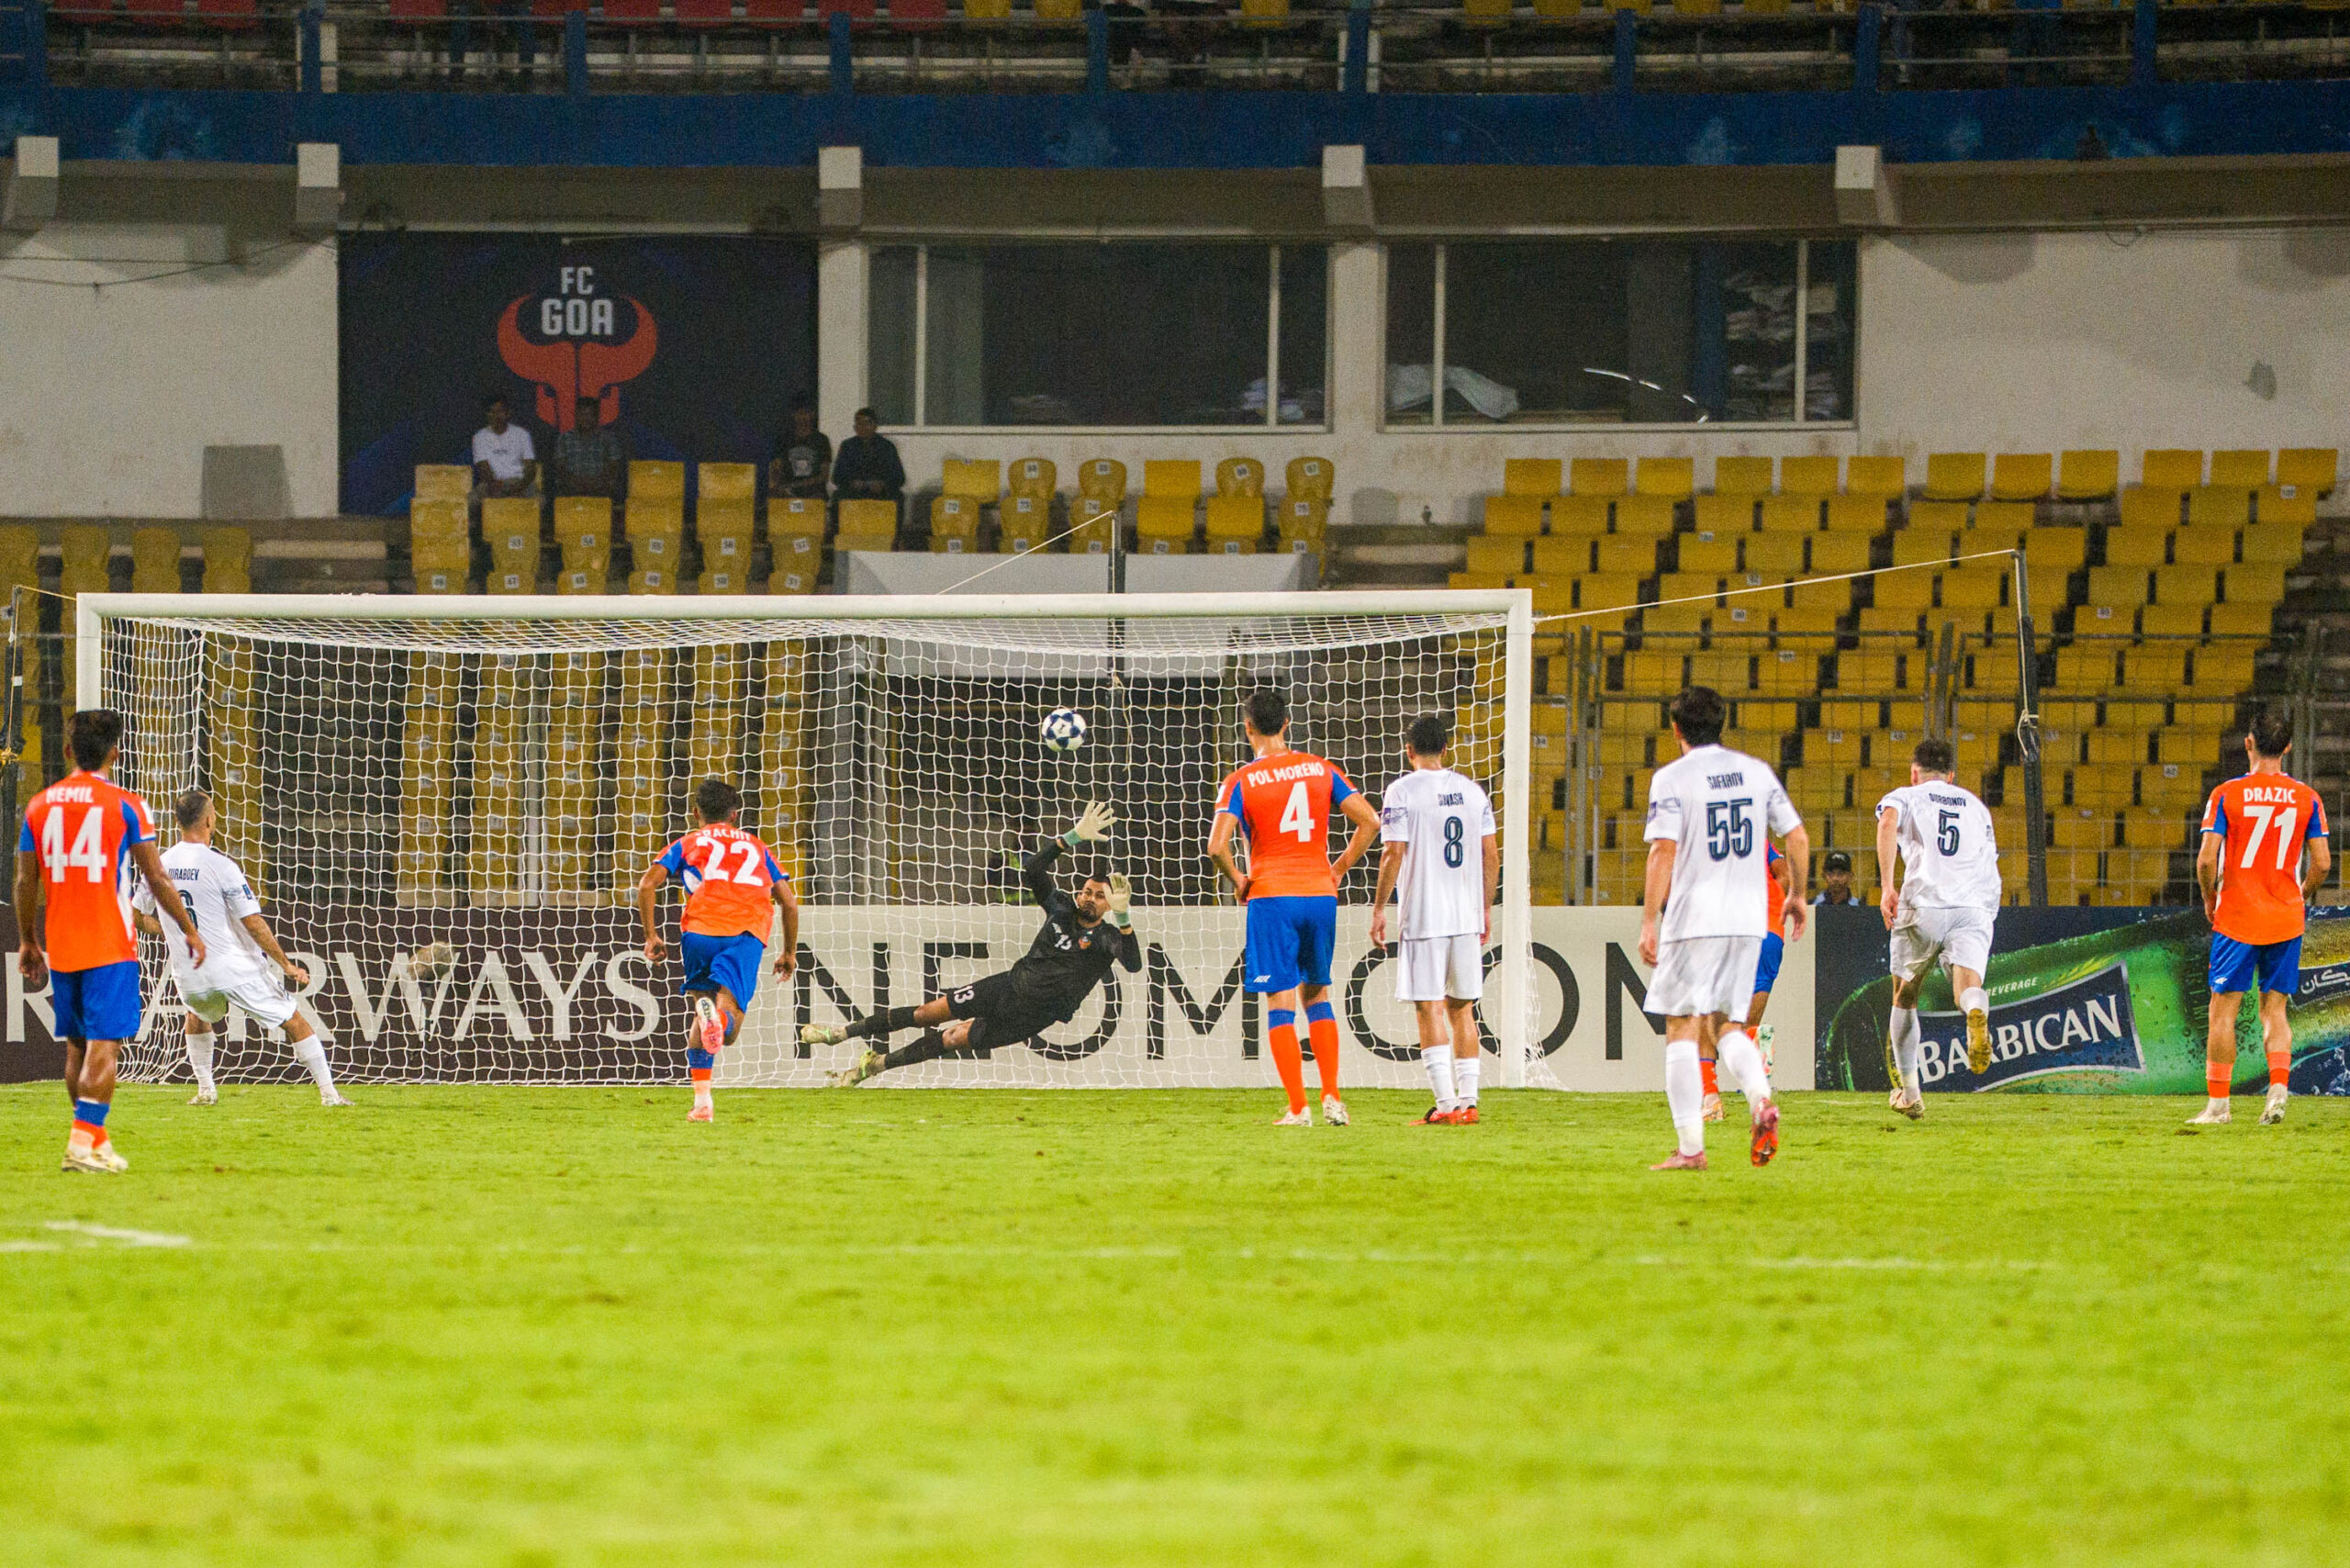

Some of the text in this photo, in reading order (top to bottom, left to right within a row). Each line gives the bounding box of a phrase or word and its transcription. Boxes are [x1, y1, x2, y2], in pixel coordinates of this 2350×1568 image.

[560, 266, 594, 295] FC
[541, 298, 614, 336] GOA
[46, 787, 94, 803] NEMIL
[1247, 762, 1325, 788] POL MORENO
[2243, 787, 2297, 804] DRAZIC
[1279, 780, 1315, 843] 4
[1706, 798, 1752, 862] 55
[1937, 809, 1960, 857] 5
[41, 806, 107, 883] 44
[696, 836, 764, 887] 22
[1444, 816, 1463, 868] 8
[2240, 805, 2298, 870] 71
[1917, 994, 2122, 1085] BABICAN
